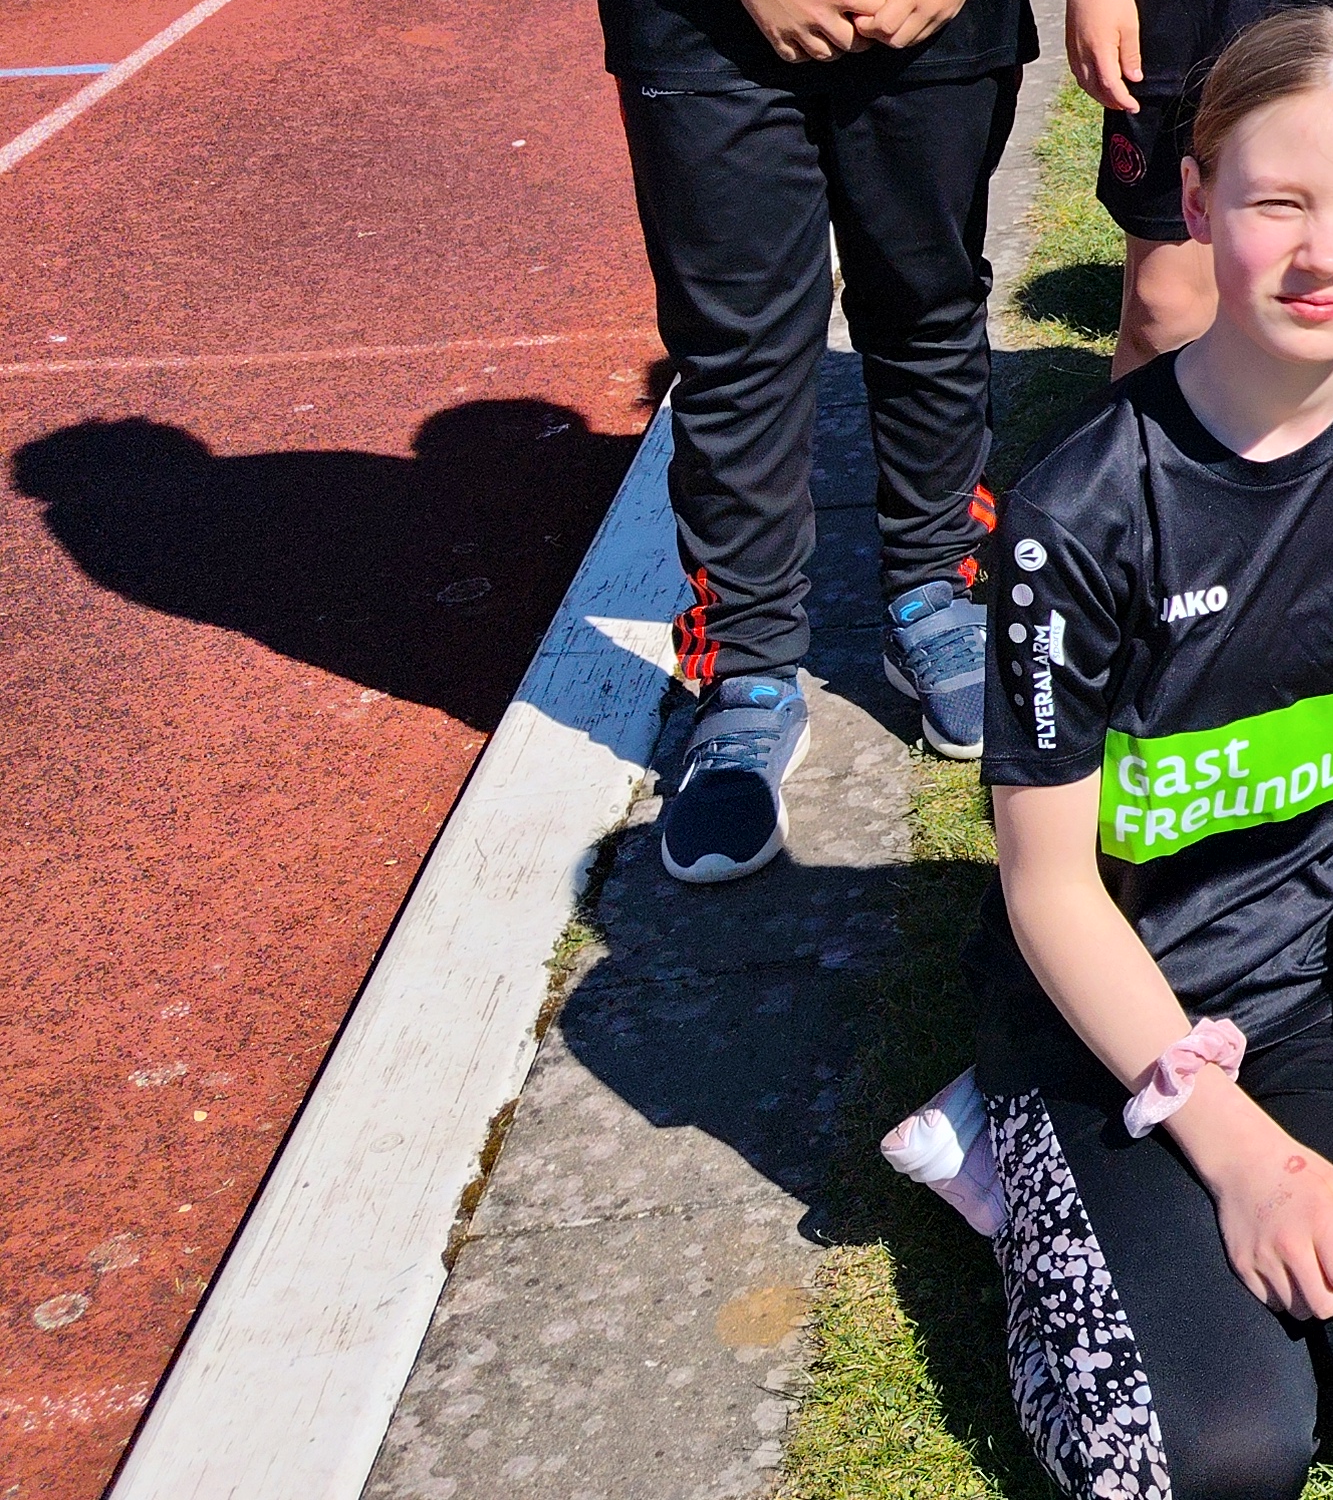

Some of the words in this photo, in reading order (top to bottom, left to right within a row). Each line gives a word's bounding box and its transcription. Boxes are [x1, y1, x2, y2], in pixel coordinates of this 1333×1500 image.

[1160, 584, 1228, 623] JAKO
[1032, 625, 1056, 750] FLYERALARM
[1118, 737, 1250, 798] Gast
